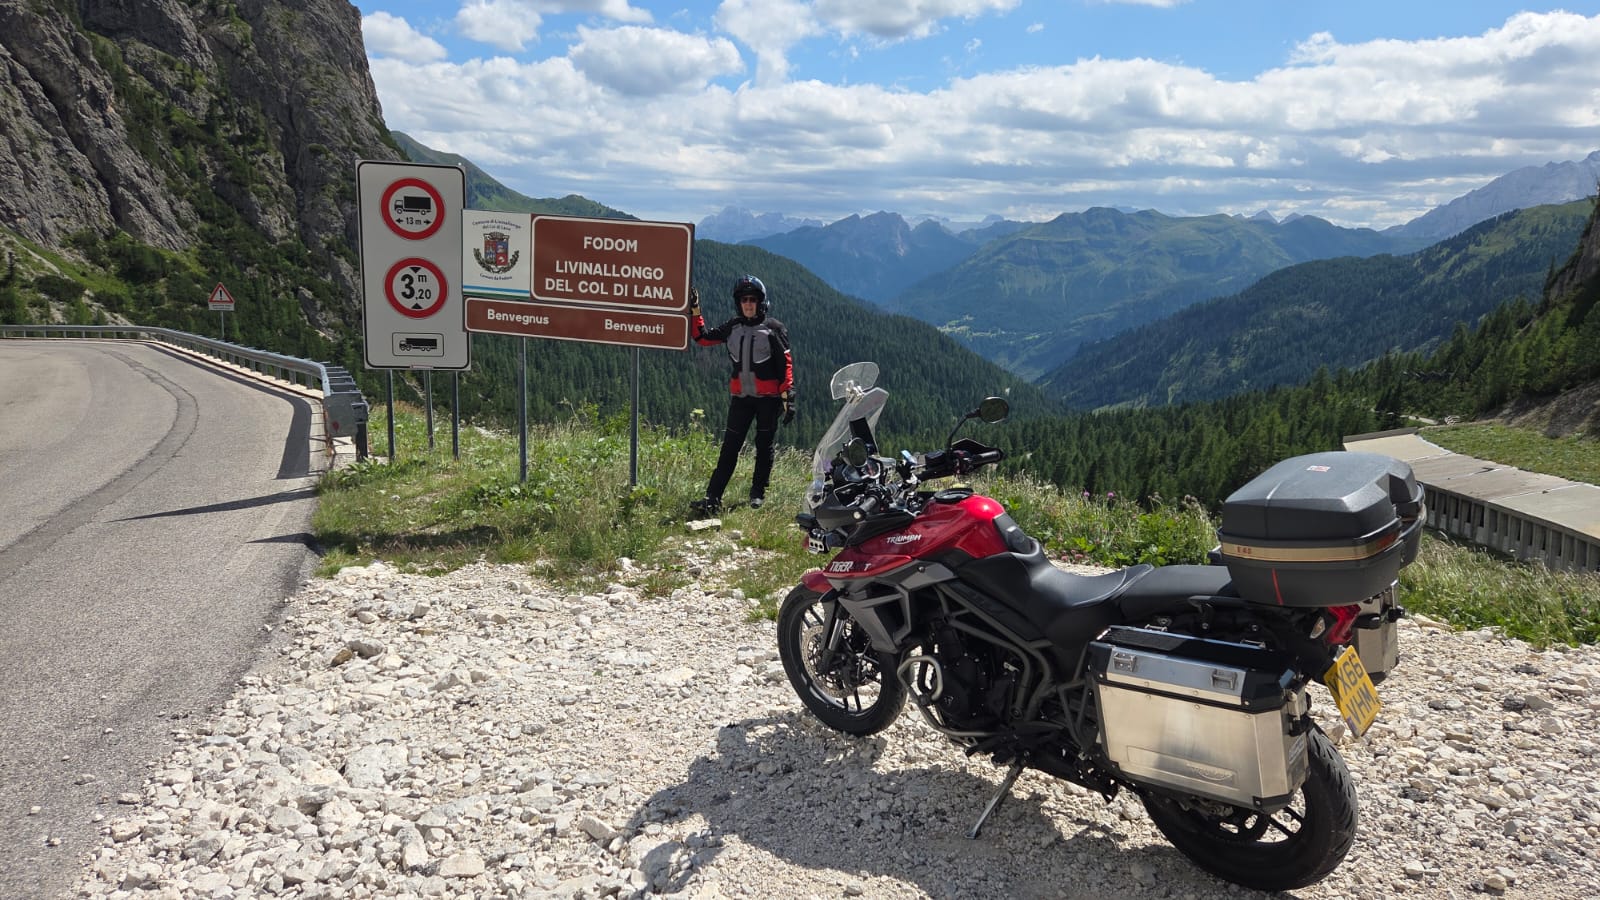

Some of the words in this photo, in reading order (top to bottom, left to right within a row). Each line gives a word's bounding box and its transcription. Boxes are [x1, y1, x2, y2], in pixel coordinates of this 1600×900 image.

[406, 217, 414, 225] 13
[584, 236, 638, 253] FODOM
[555, 260, 664, 281] LIVINALLONGO
[545, 278, 573, 293] DEL
[578, 280, 609, 295] COL
[613, 283, 628, 297] DI
[633, 284, 674, 300] LANA
[487, 308, 549, 326] Benvegnus
[604, 319, 664, 335] Benvenuti
[886, 533, 922, 545] TRIUMPH
[829, 561, 854, 573] TIGER
[1346, 683, 1377, 725] VHM
